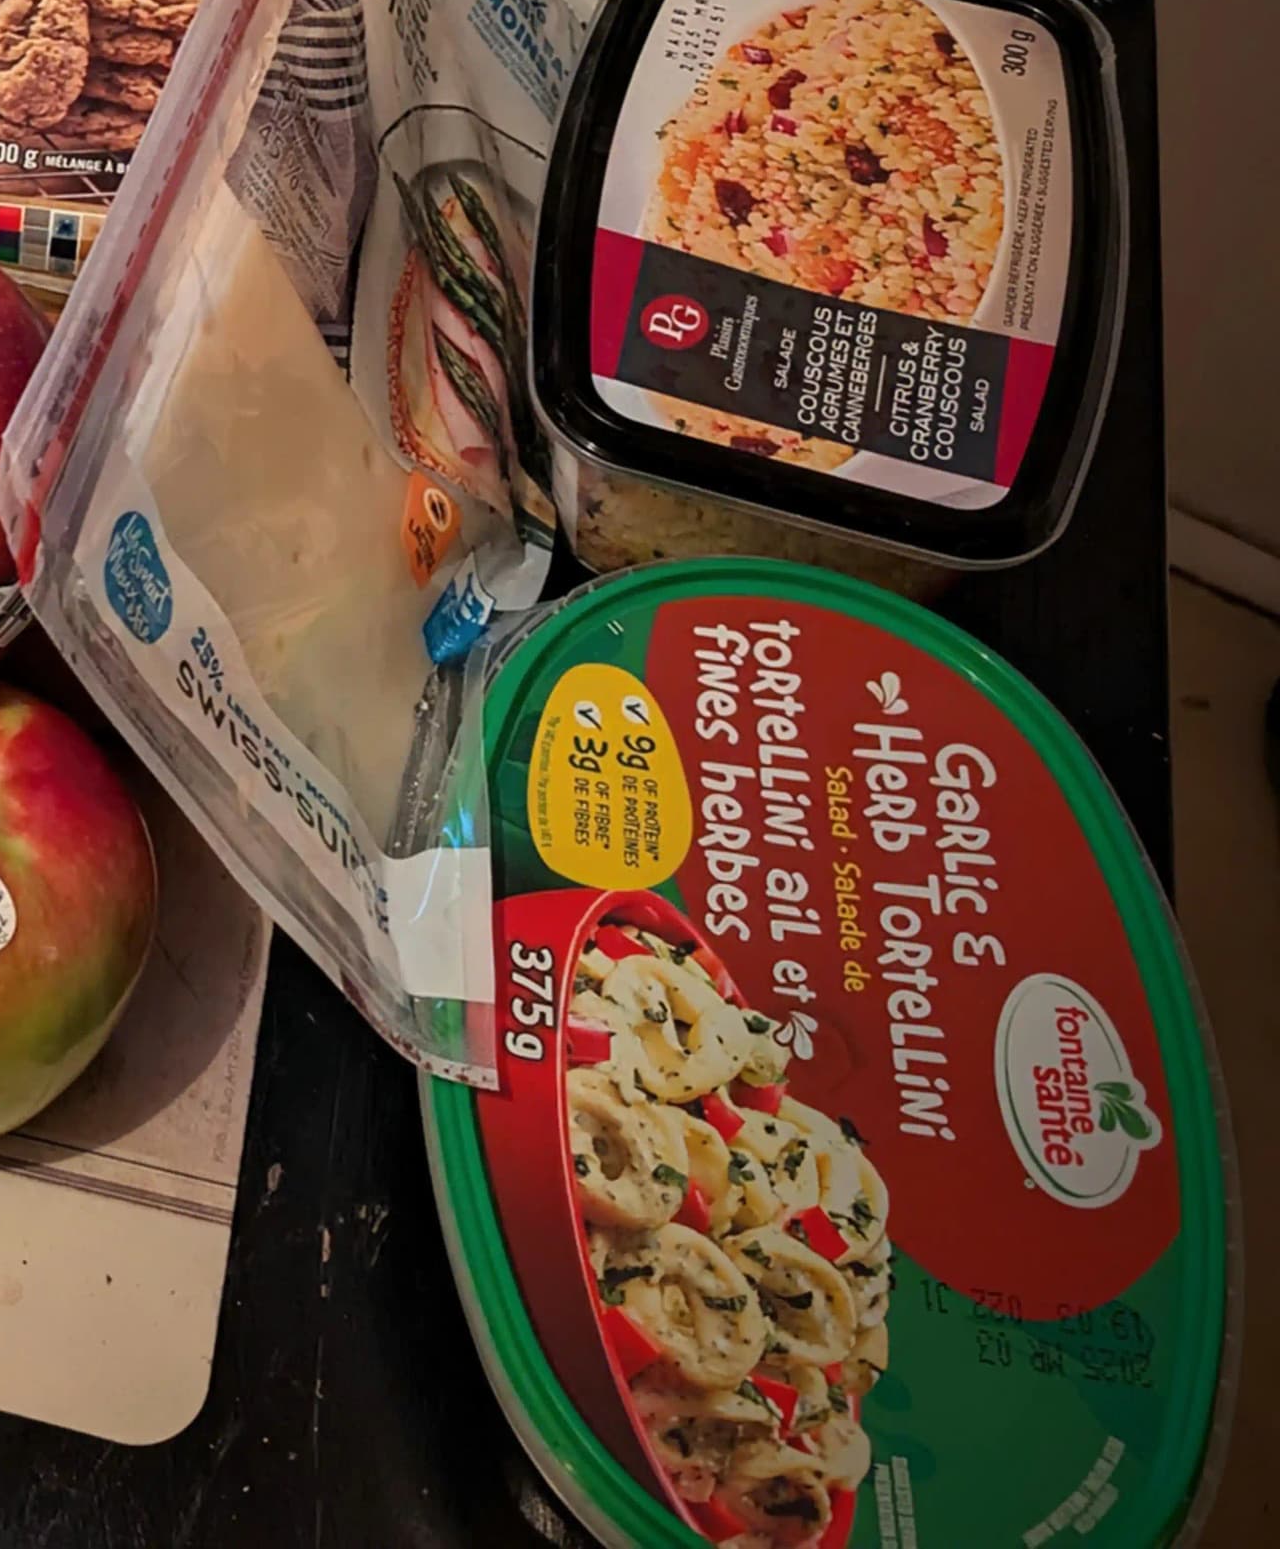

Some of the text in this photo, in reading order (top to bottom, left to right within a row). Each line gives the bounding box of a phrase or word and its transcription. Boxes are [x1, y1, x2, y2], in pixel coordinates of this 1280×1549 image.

[1001, 45, 1028, 78] 300
[45, 152, 102, 172] MÉLANGE
[773, 326, 798, 390] SALADE
[797, 305, 834, 426] COUSCOUS
[823, 312, 855, 434] AGRUMES ET
[841, 310, 878, 445] CANNEBERGES
[889, 355, 917, 438] CITRUS
[909, 325, 947, 462] CRANBERRY
[933, 336, 968, 462] COUSCOUS
[969, 377, 991, 434] SALAD
[568, 735, 609, 774] 3g
[616, 735, 657, 772] 9g
[623, 775, 638, 792] DE
[574, 777, 589, 847] DE FIBRES
[772, 958, 816, 1004] et
[1051, 1003, 1096, 1137] fontaine
[1032, 1066, 1084, 1168] santé
